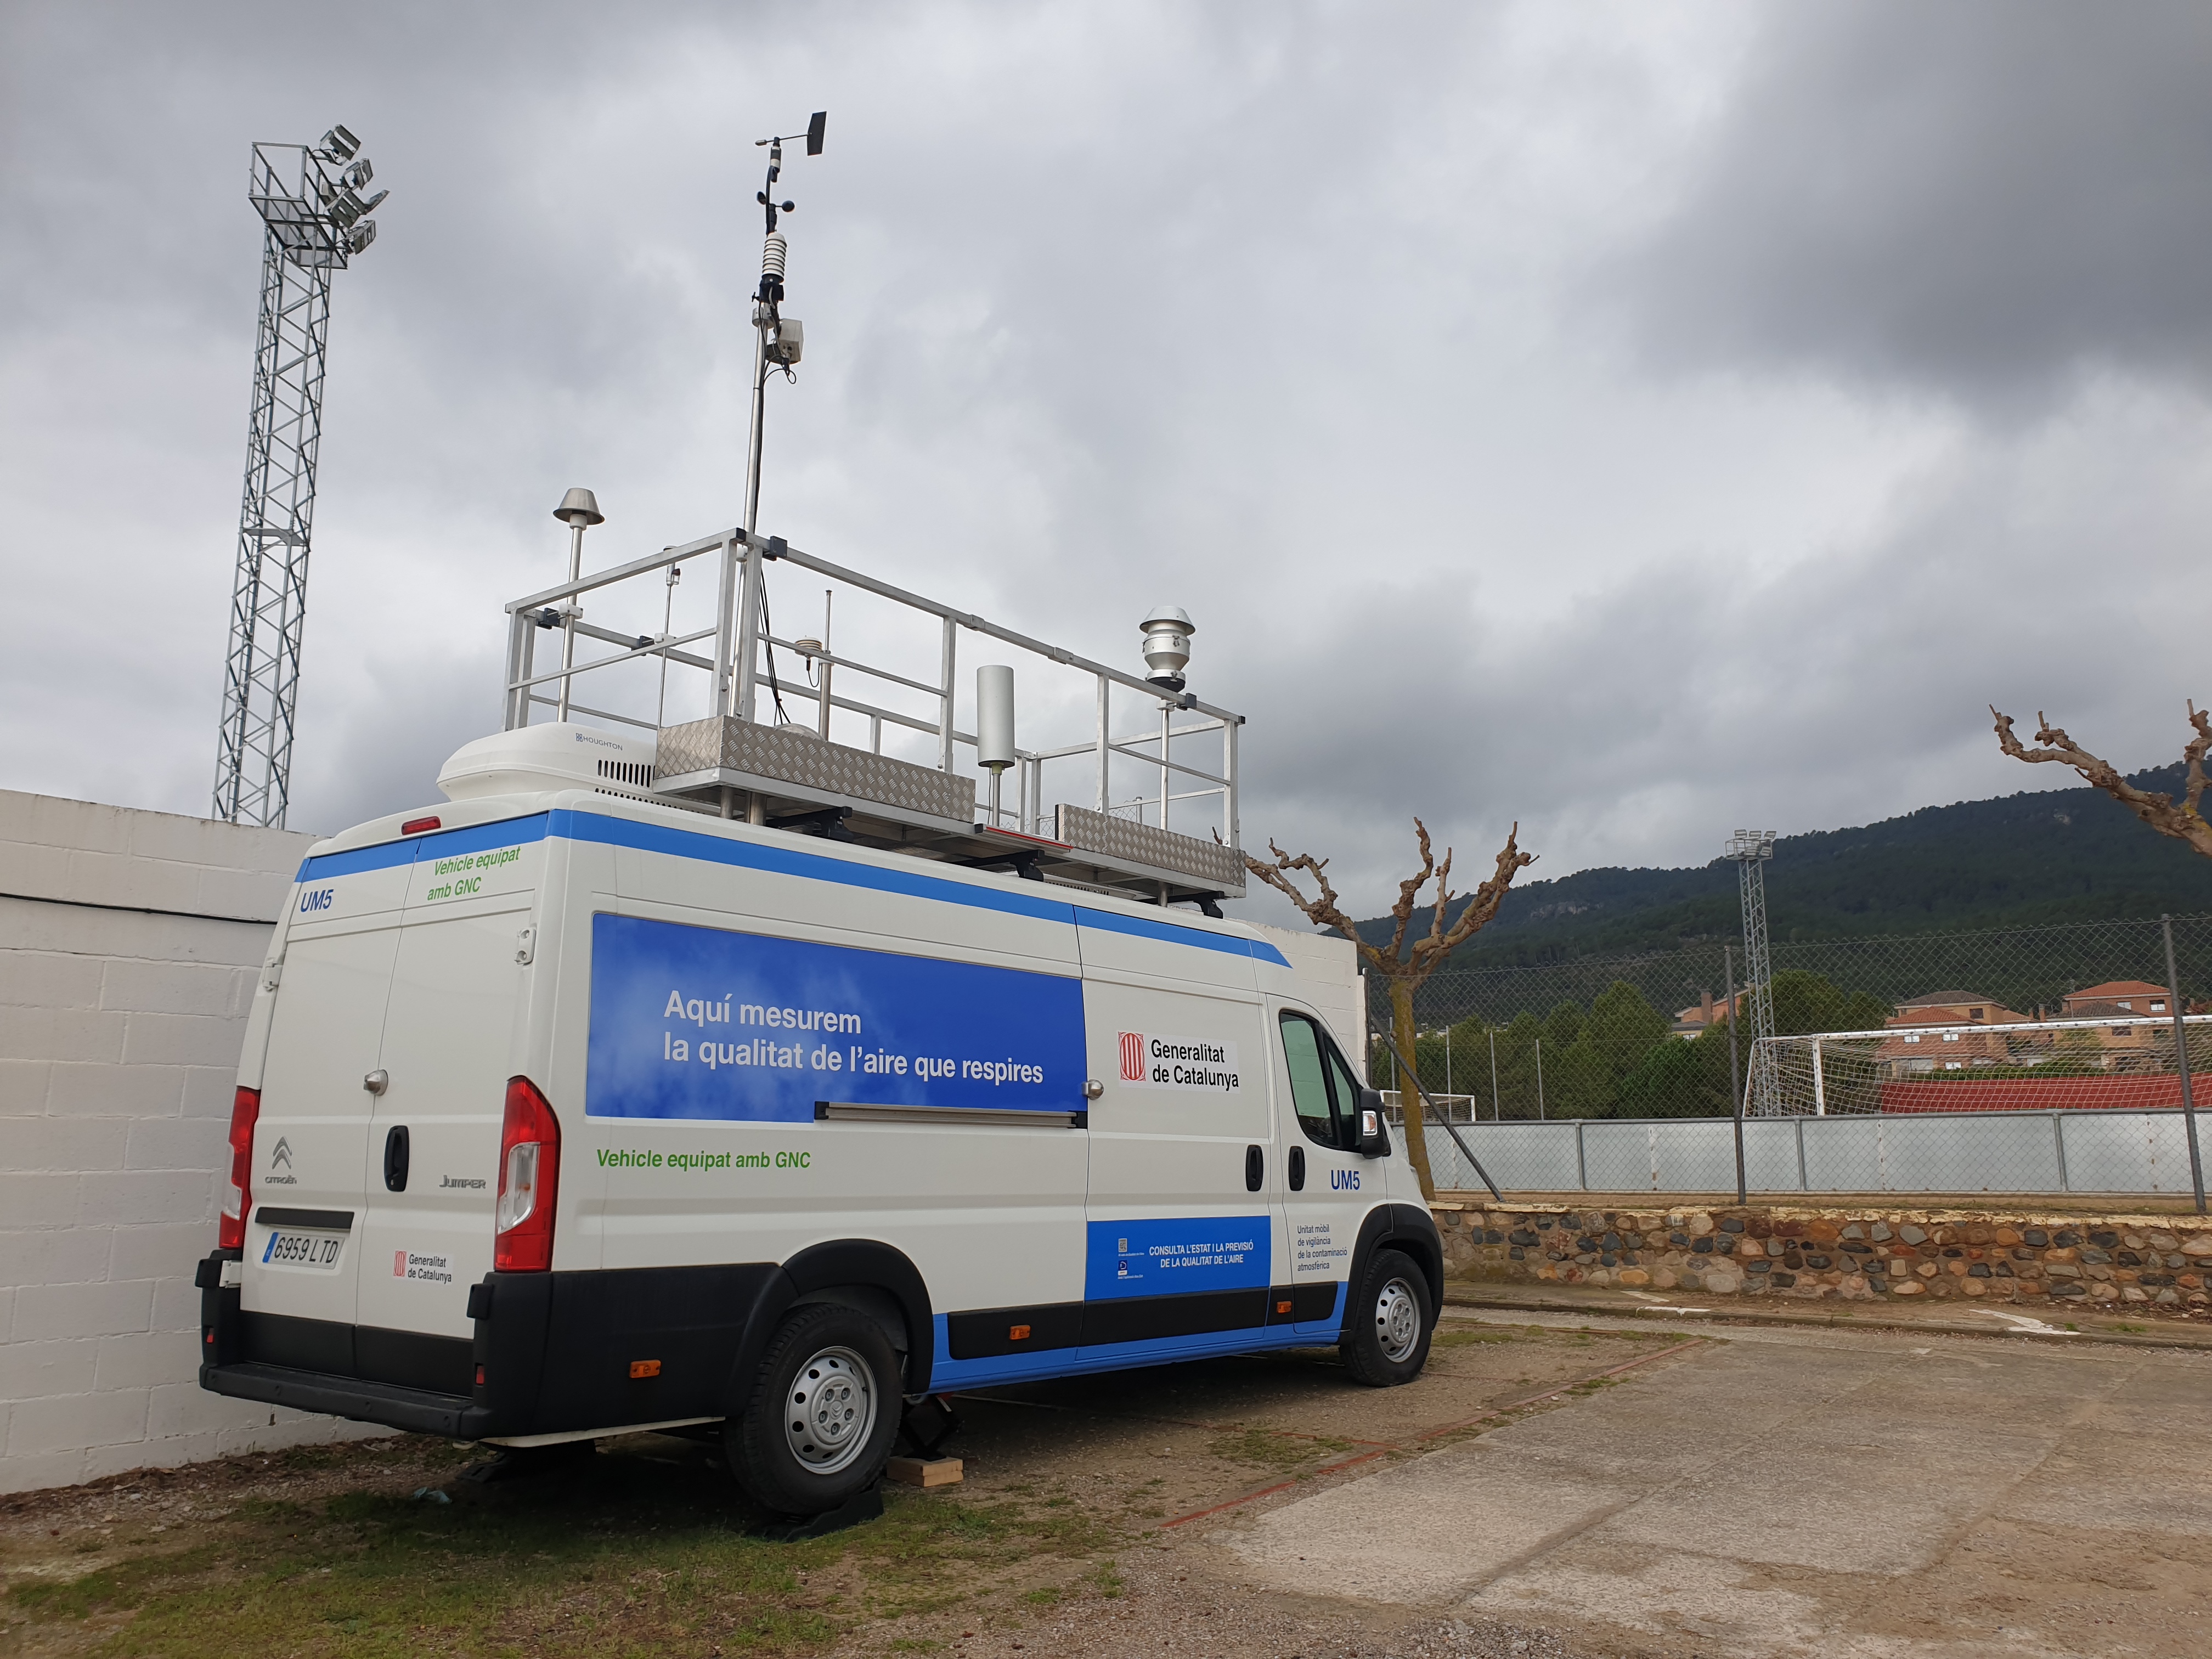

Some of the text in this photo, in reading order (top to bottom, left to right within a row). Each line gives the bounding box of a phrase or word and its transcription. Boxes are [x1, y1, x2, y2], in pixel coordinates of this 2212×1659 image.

[583, 736, 623, 751] HOUGHTON
[435, 846, 521, 876] Vehicle equipat
[427, 876, 481, 901] amb GNC
[300, 888, 334, 912] UM5
[664, 990, 861, 1034] Aquí mesurem
[664, 1031, 689, 1061] la
[698, 1039, 803, 1070] qualitat
[811, 1043, 842, 1071] de
[915, 1056, 956, 1082] que
[962, 1057, 1043, 1086] respires
[1151, 1039, 1225, 1063] Generalitat
[1153, 1064, 1239, 1091] de Catalunya
[597, 1149, 811, 1172] Vehicle equipat amb GNC
[1331, 1170, 1360, 1190] UM5
[1297, 1223, 1329, 1234] Unitat mòbil
[274, 1237, 338, 1263] 6959 LTD
[1149, 1245, 1185, 1255] CONSULTA
[1186, 1244, 1211, 1254] L'ESTAT
[1212, 1243, 1215, 1252] I
[1216, 1243, 1224, 1252] LA
[1225, 1239, 1254, 1251] PREVISIÓ
[1298, 1236, 1330, 1248] de vigilància
[409, 1254, 446, 1267] Generalitat
[1160, 1254, 1244, 1268] DE LA QUALITAT DE L'AIRE
[1298, 1246, 1347, 1259] de la contaminació
[408, 1268, 452, 1284] de Catalunya
[1297, 1261, 1329, 1271] atmosfèrica
